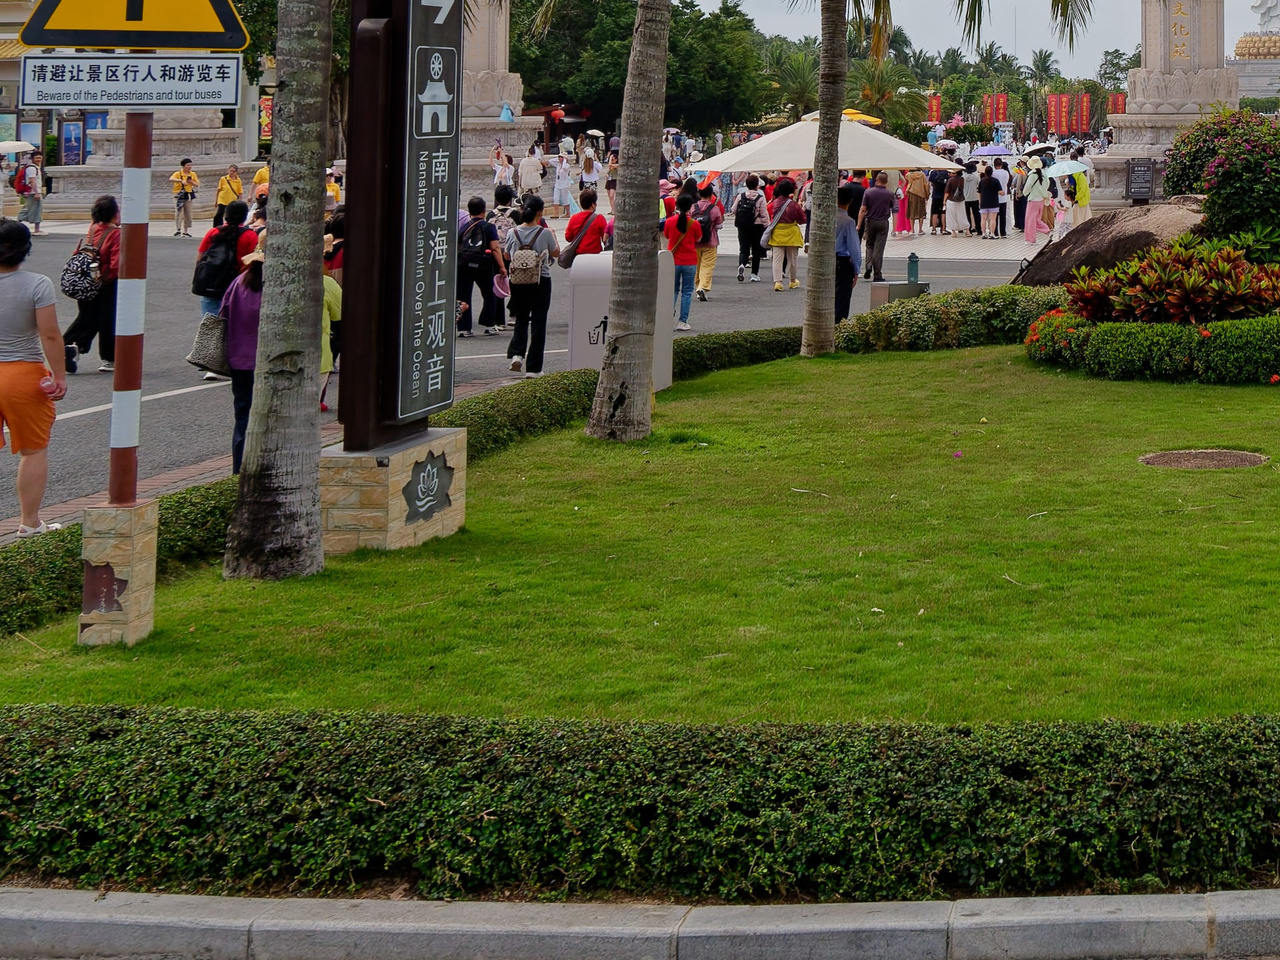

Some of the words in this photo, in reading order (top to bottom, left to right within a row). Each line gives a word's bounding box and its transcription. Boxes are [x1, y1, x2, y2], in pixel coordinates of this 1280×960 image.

[31, 64, 231, 82] 请避让景区行人和游览车
[37, 90, 71, 101] Beware
[73, 90, 84, 100] of
[84, 90, 98, 100] the
[100, 90, 154, 101] Pedestrians
[156, 90, 173, 100] and
[174, 90, 192, 100] tour
[194, 90, 222, 100] buses
[418, 151, 429, 214] Nanshan
[415, 219, 427, 278] Guanyin
[426, 148, 450, 393] 南山海上观音
[414, 282, 425, 315] Over
[413, 318, 424, 347] The
[411, 350, 423, 398] Ocean
